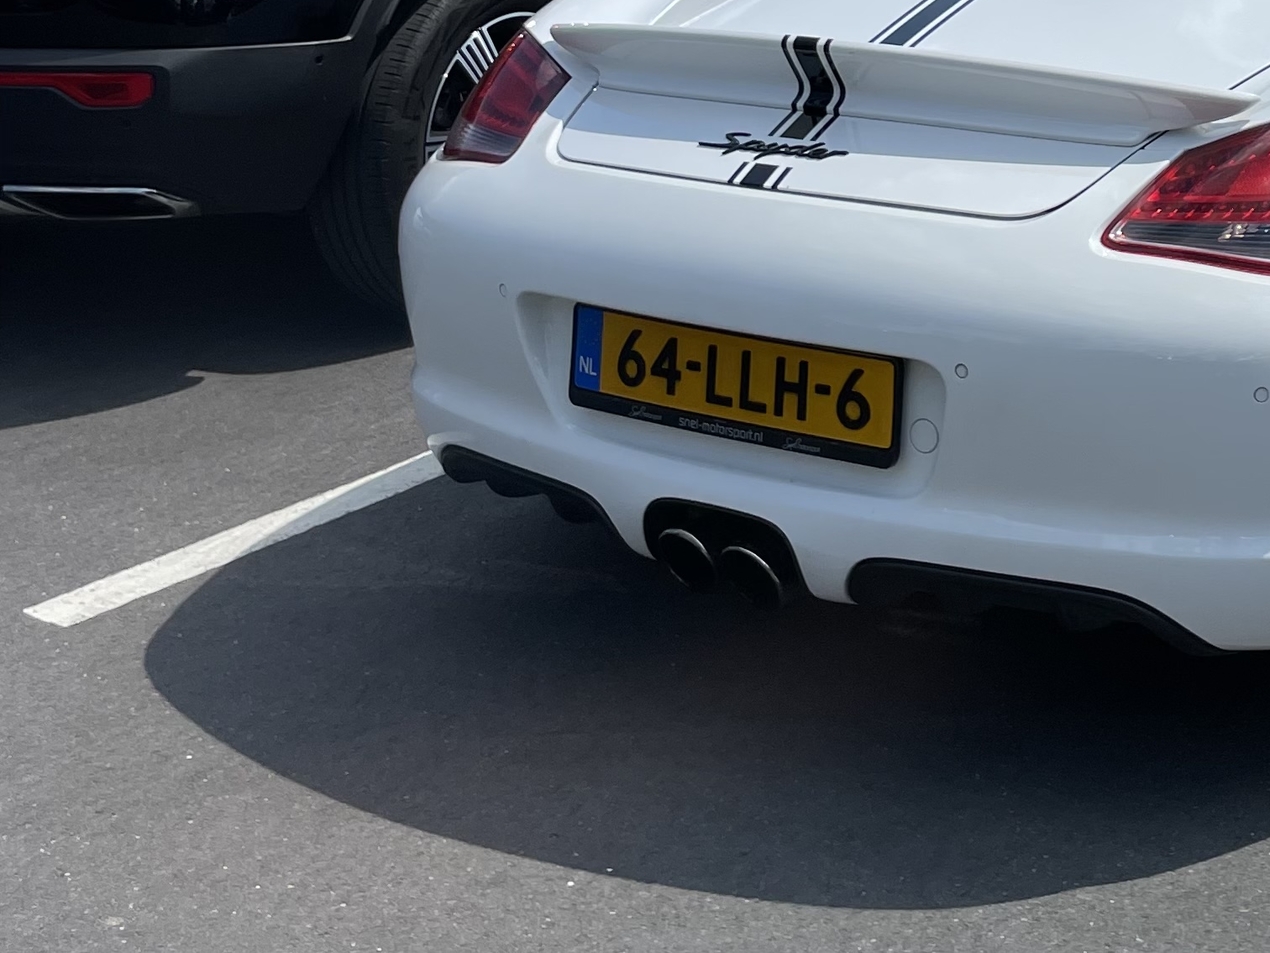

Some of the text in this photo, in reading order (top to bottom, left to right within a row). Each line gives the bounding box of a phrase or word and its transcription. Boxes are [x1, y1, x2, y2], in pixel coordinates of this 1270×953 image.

[698, 132, 849, 160] Spyder
[578, 355, 598, 377] NL
[616, 329, 871, 431] 64-LLH-6
[678, 417, 764, 443] snel-motorsport.nl
